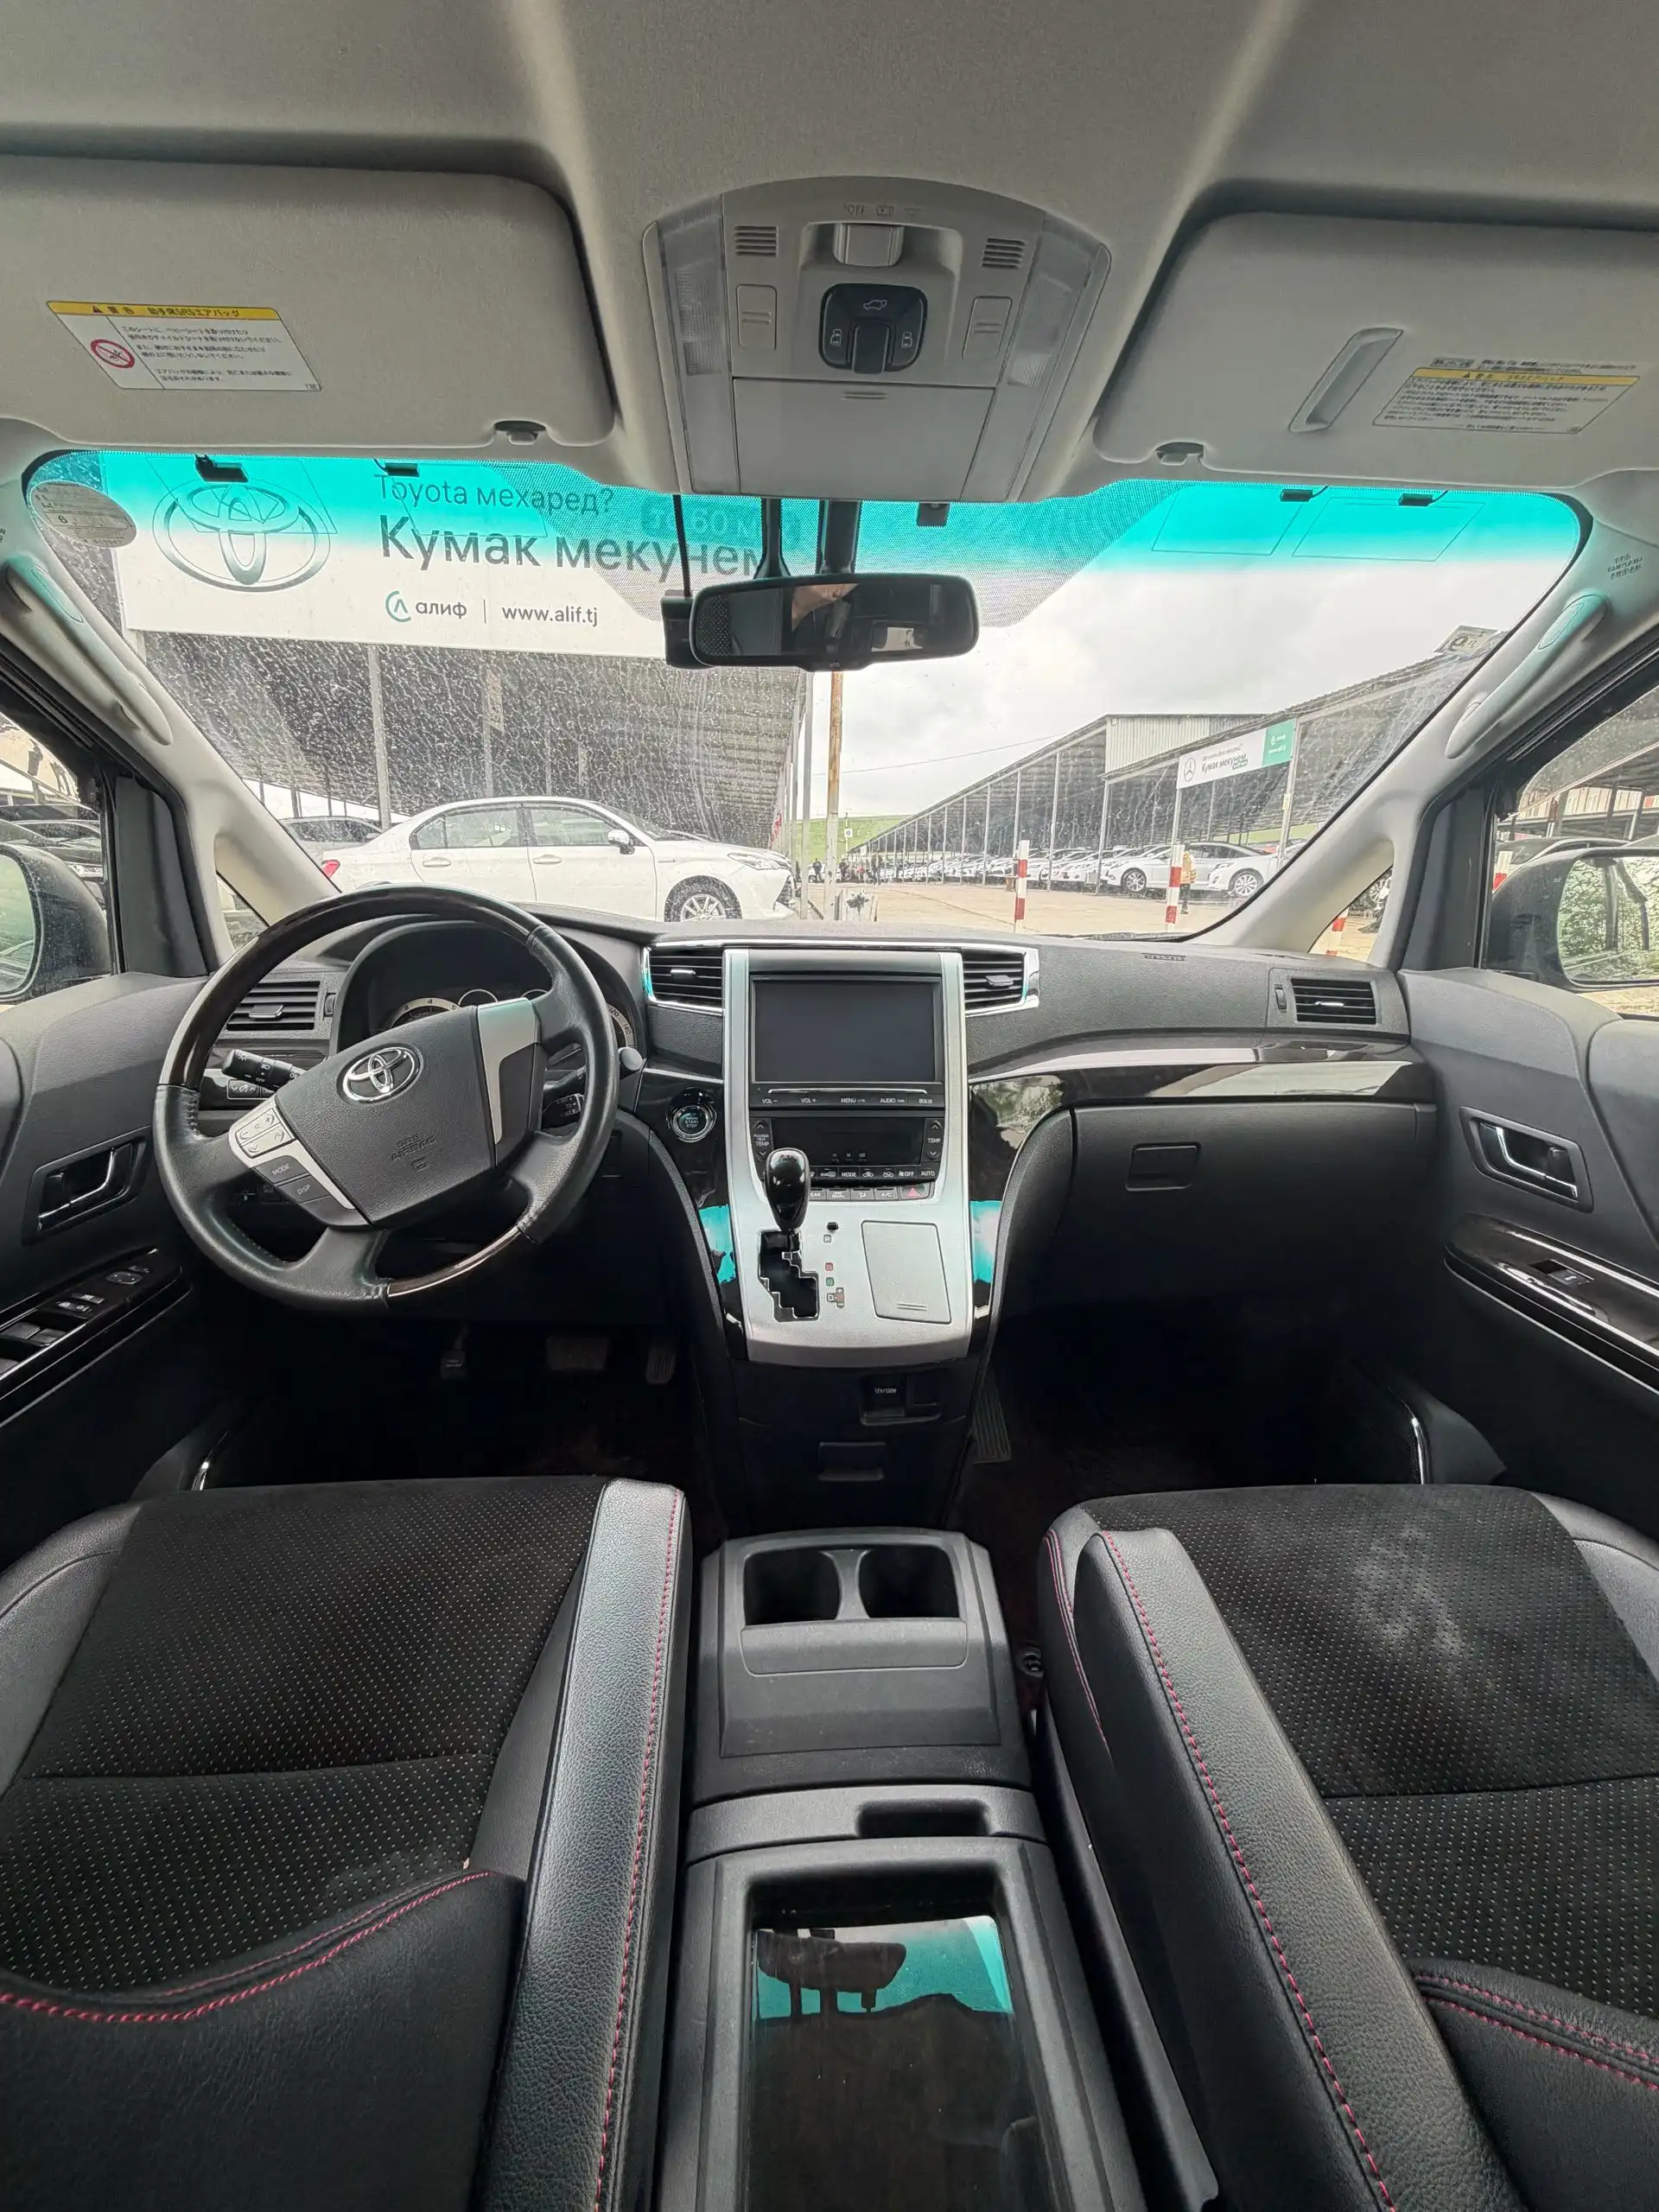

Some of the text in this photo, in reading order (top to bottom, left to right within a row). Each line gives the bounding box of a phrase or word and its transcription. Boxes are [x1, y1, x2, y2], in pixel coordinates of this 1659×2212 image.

[374, 474, 614, 517] Toyota мехаред?
[379, 514, 541, 571] Кумак
[416, 601, 467, 620] алиф
[502, 606, 598, 626] www.alif.tj
[270, 1163, 291, 1175] MODE
[296, 1184, 310, 1195] DISP
